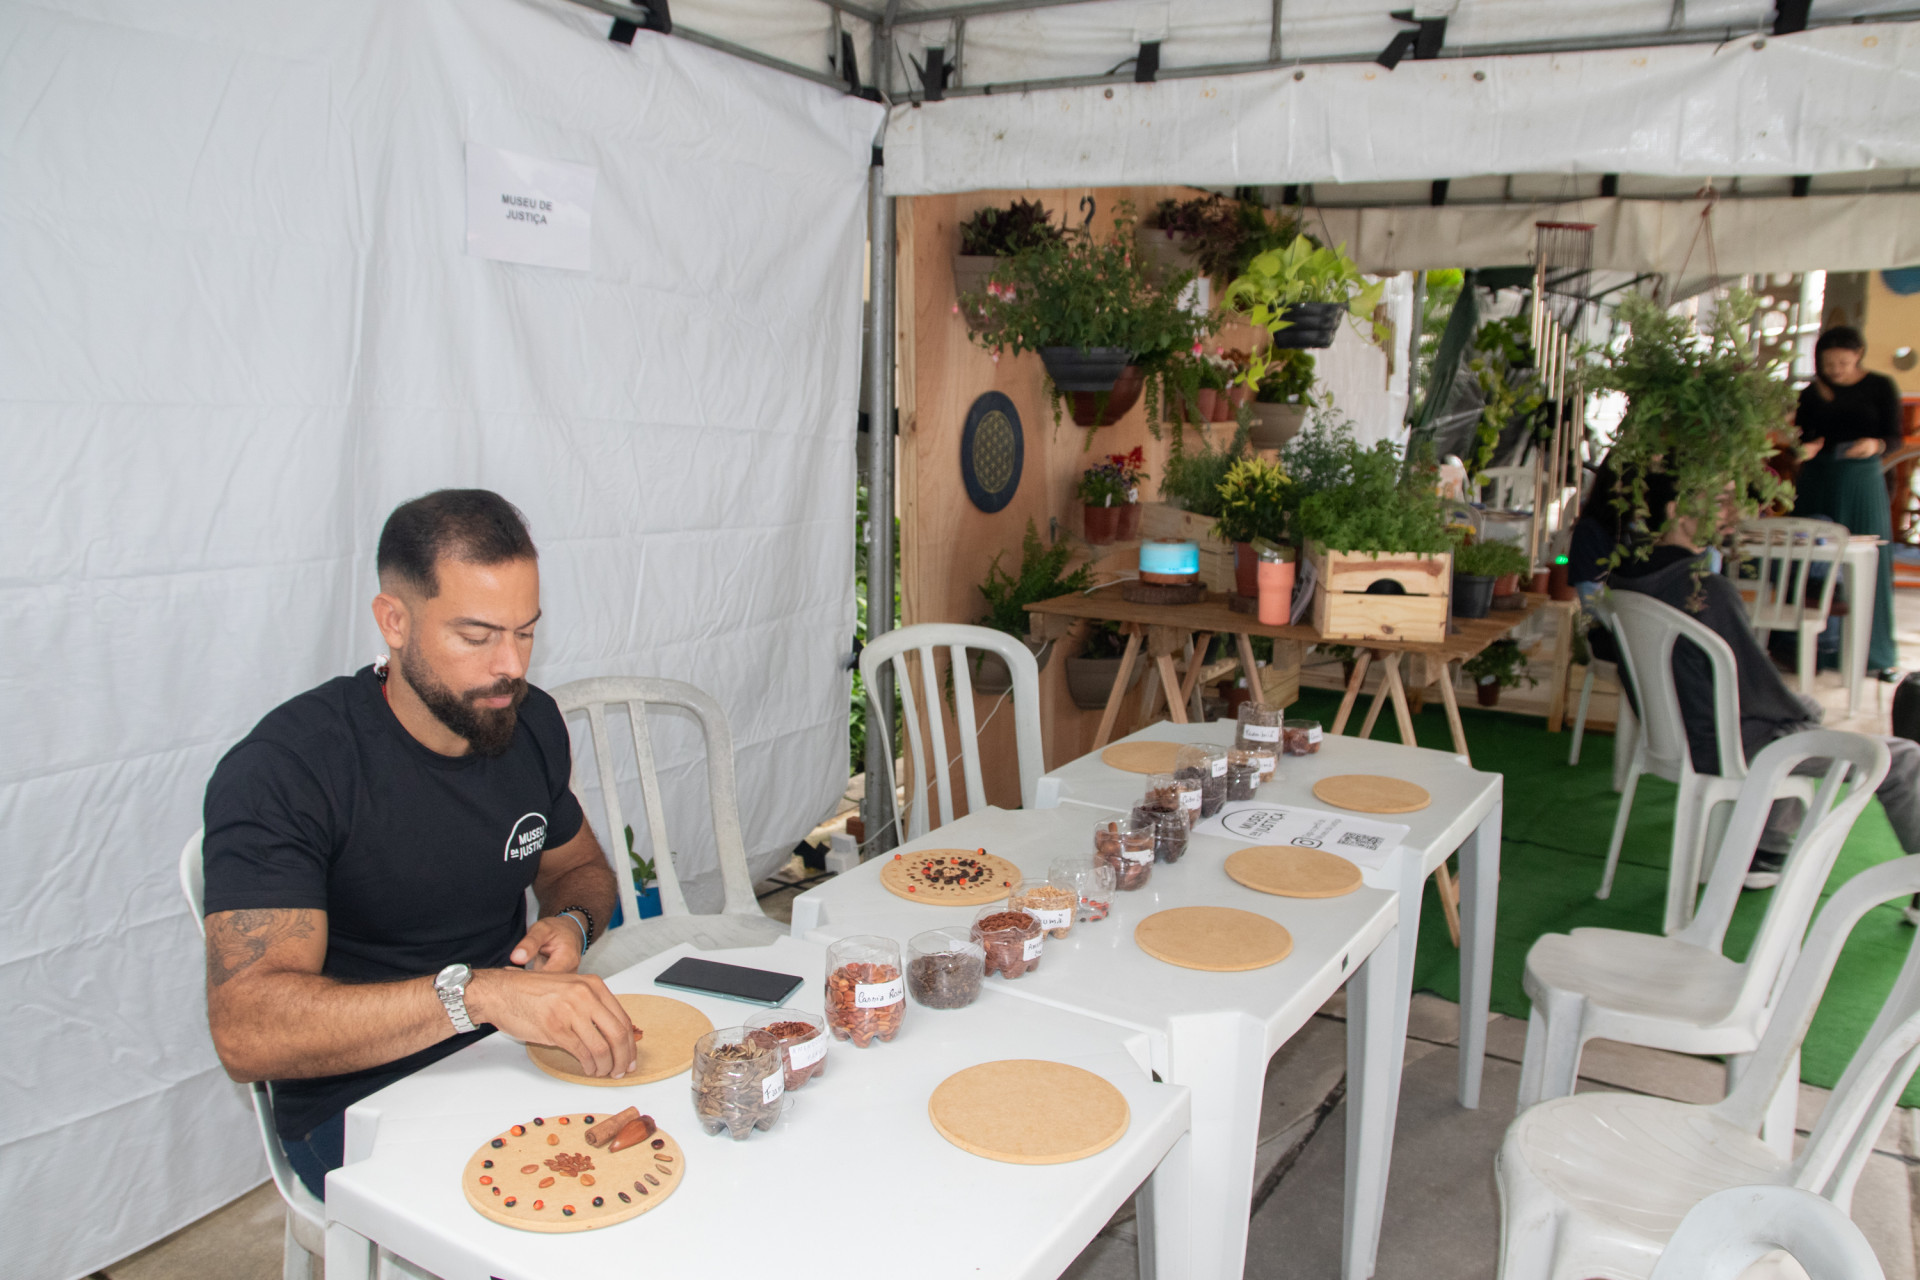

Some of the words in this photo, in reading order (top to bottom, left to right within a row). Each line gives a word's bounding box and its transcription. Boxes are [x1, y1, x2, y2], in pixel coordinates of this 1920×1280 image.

[501, 193, 536, 209] MUSEU
[539, 199, 553, 211] DE
[505, 208, 548, 225] JUSTIÇA
[1238, 811, 1268, 829] MUSEU
[1255, 812, 1287, 834] JUSTIÇA
[518, 825, 545, 845] MUSEU
[510, 848, 519, 857] DA
